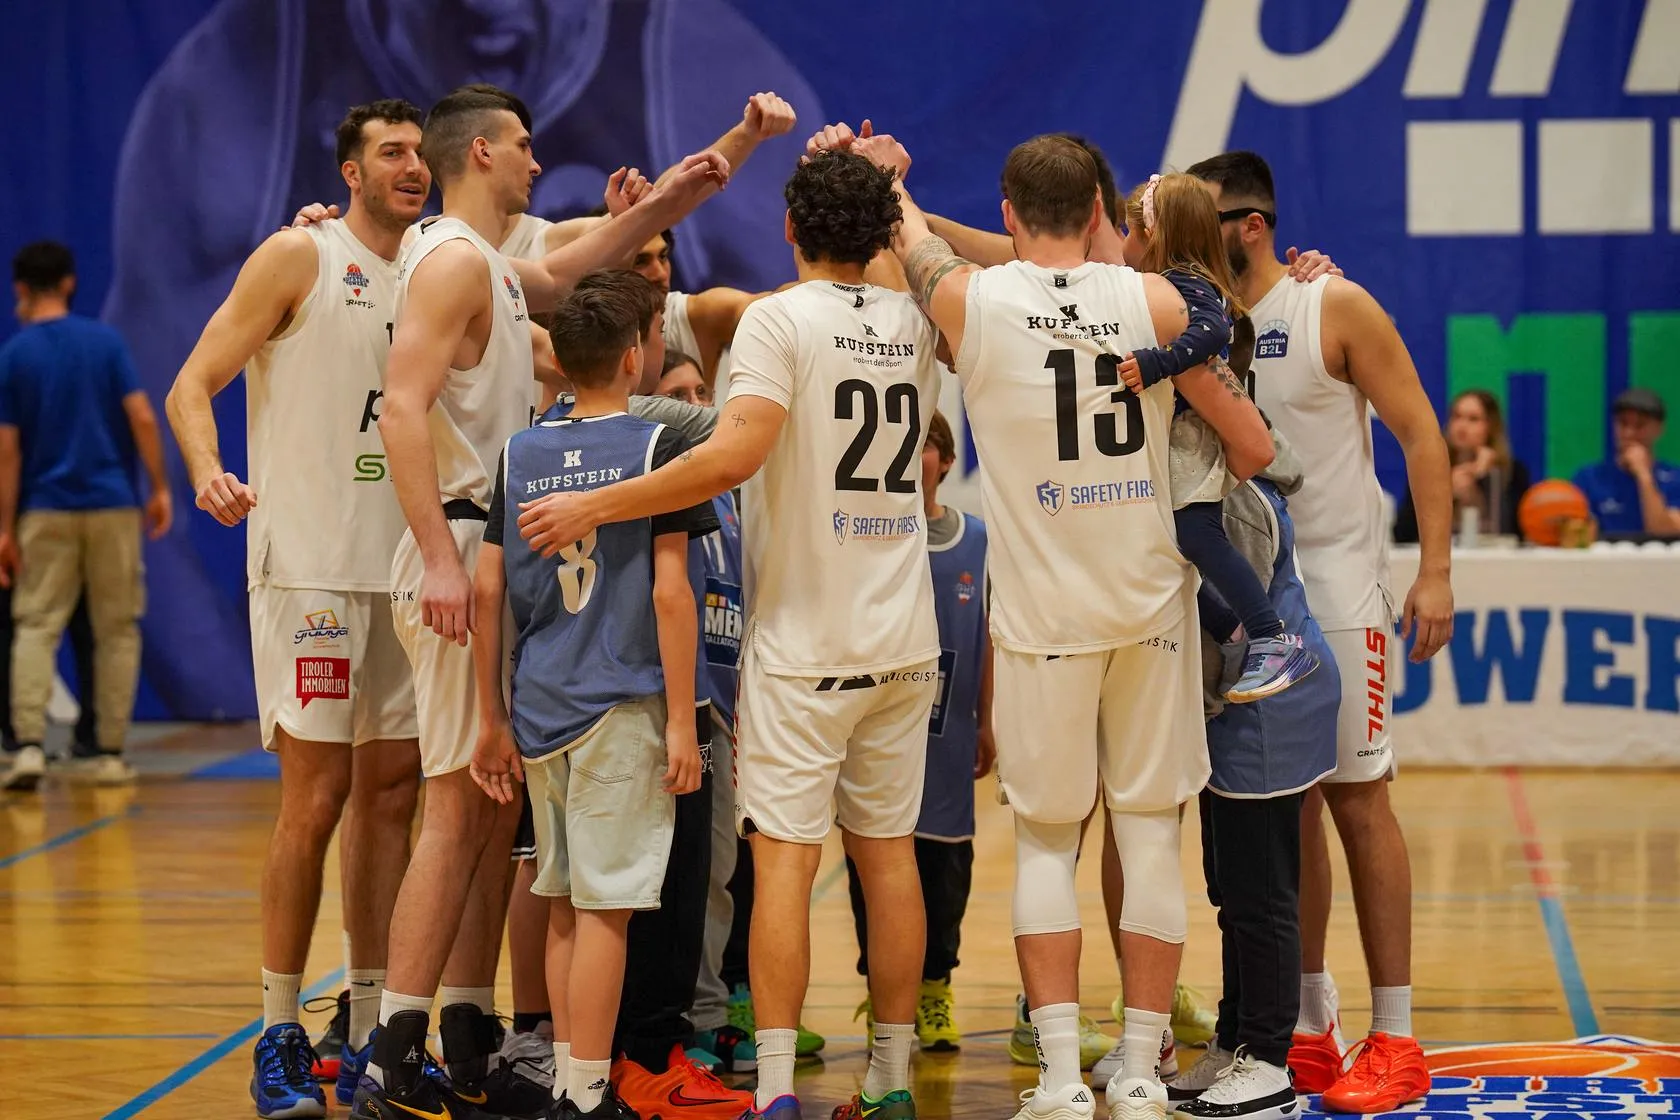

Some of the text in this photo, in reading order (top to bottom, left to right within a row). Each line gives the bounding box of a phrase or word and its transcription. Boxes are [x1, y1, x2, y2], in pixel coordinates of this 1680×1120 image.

[833, 336, 914, 356] KUFSTEIN
[1260, 345, 1283, 355] B2L
[1044, 349, 1145, 461] 13
[834, 379, 920, 493] 22
[564, 450, 582, 467] K
[526, 468, 623, 494] KUFSTEIN
[1070, 483, 1122, 505] SAFETY
[1127, 480, 1155, 498] FIRS
[853, 517, 896, 536] SAFETY
[301, 662, 333, 677] TIROLER
[301, 678, 346, 694] IMMOBILIEN
[1366, 628, 1386, 743] STIHL
[1033, 1026, 1045, 1058] CRAFT
